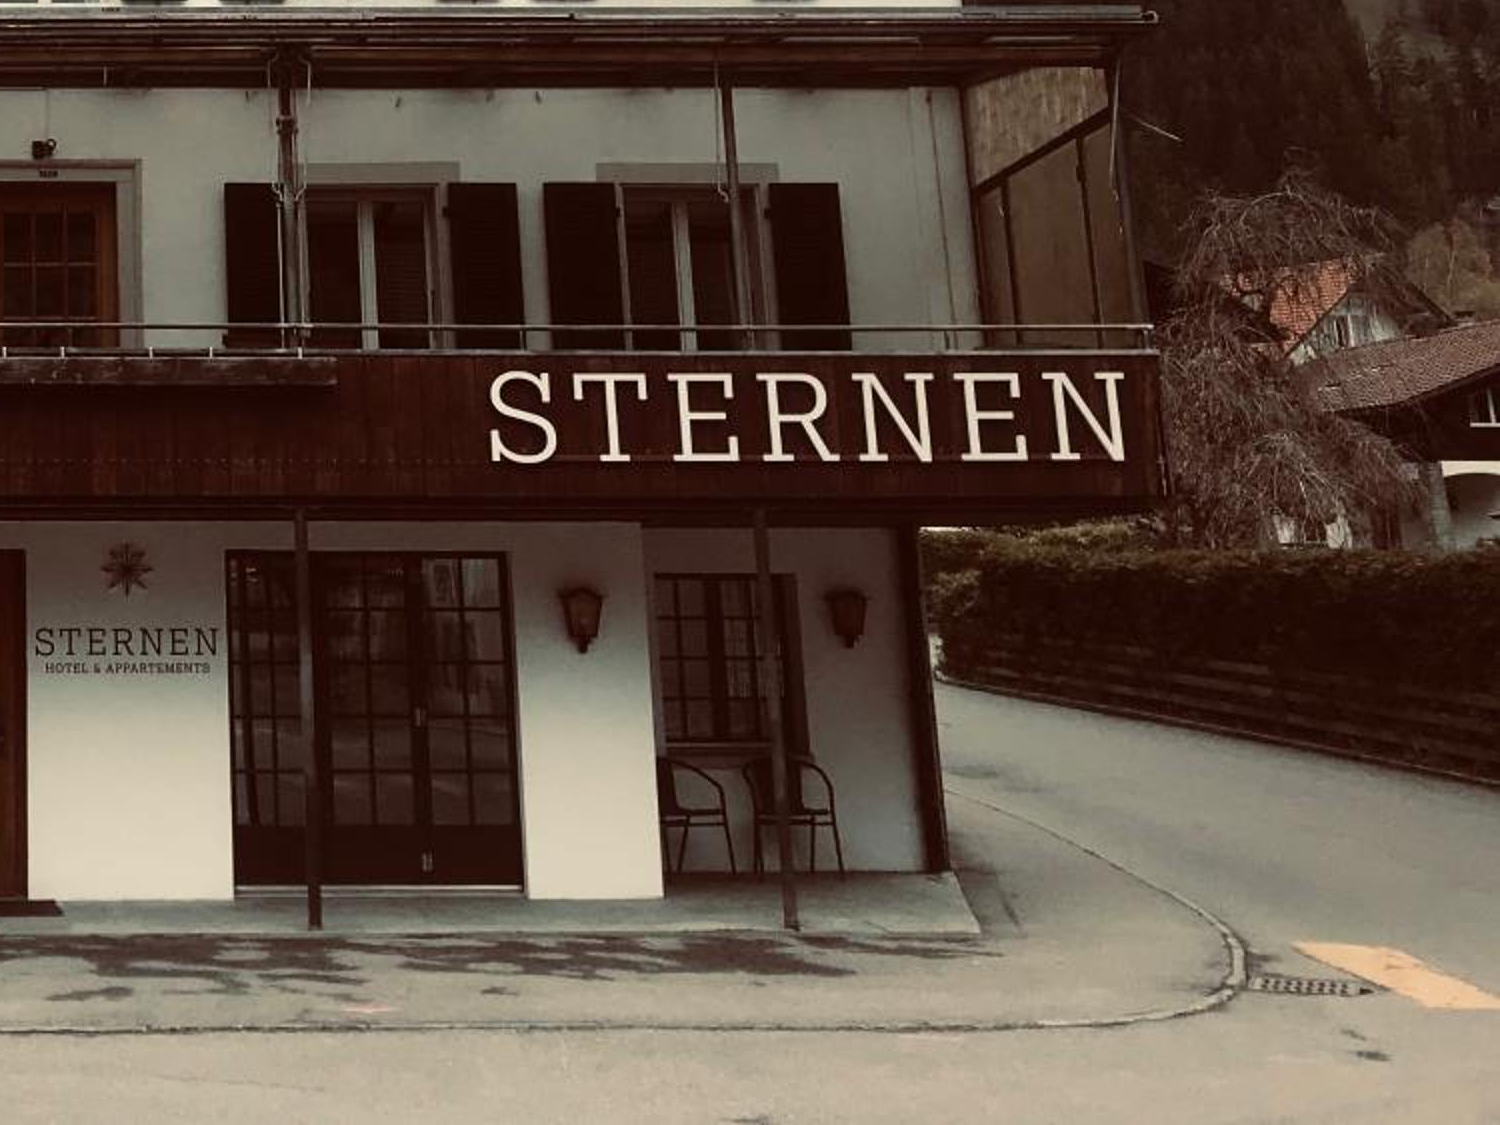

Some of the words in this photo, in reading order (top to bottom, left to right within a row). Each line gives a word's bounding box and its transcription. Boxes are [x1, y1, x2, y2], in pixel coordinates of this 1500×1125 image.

[489, 370, 1125, 463] STERNEN
[35, 628, 220, 656] STERNEN
[45, 662, 88, 674] HOTEL
[105, 662, 212, 674] APPARTEMENTS
